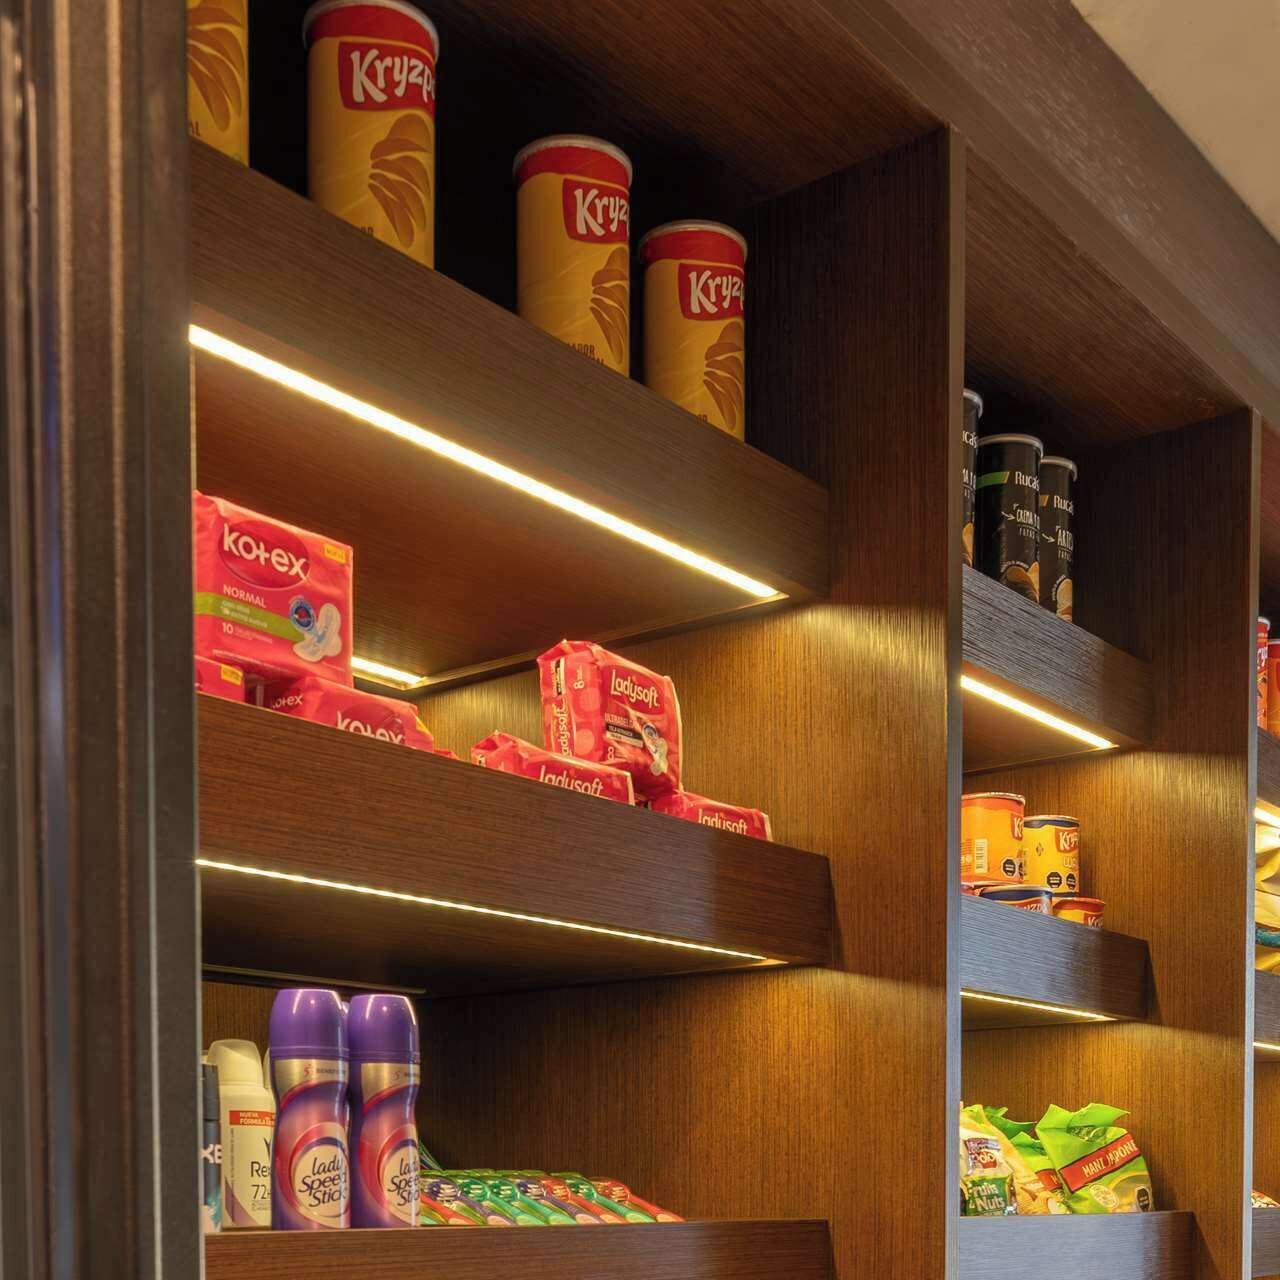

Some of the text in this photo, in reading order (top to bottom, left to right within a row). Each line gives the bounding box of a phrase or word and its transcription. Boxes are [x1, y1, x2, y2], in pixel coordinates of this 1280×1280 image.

[350, 48, 435, 103] Kryzp
[574, 188, 630, 236] Kryz
[689, 269, 744, 314] Kryz
[223, 584, 267, 609] NORMAL
[222, 622, 233, 634] 10
[610, 669, 659, 709] Ladysoft
[553, 698, 574, 757] adysoft
[607, 746, 615, 761] 8
[1106, 1138, 1139, 1168] JAPONE
[975, 1196, 1005, 1211] Nuts
